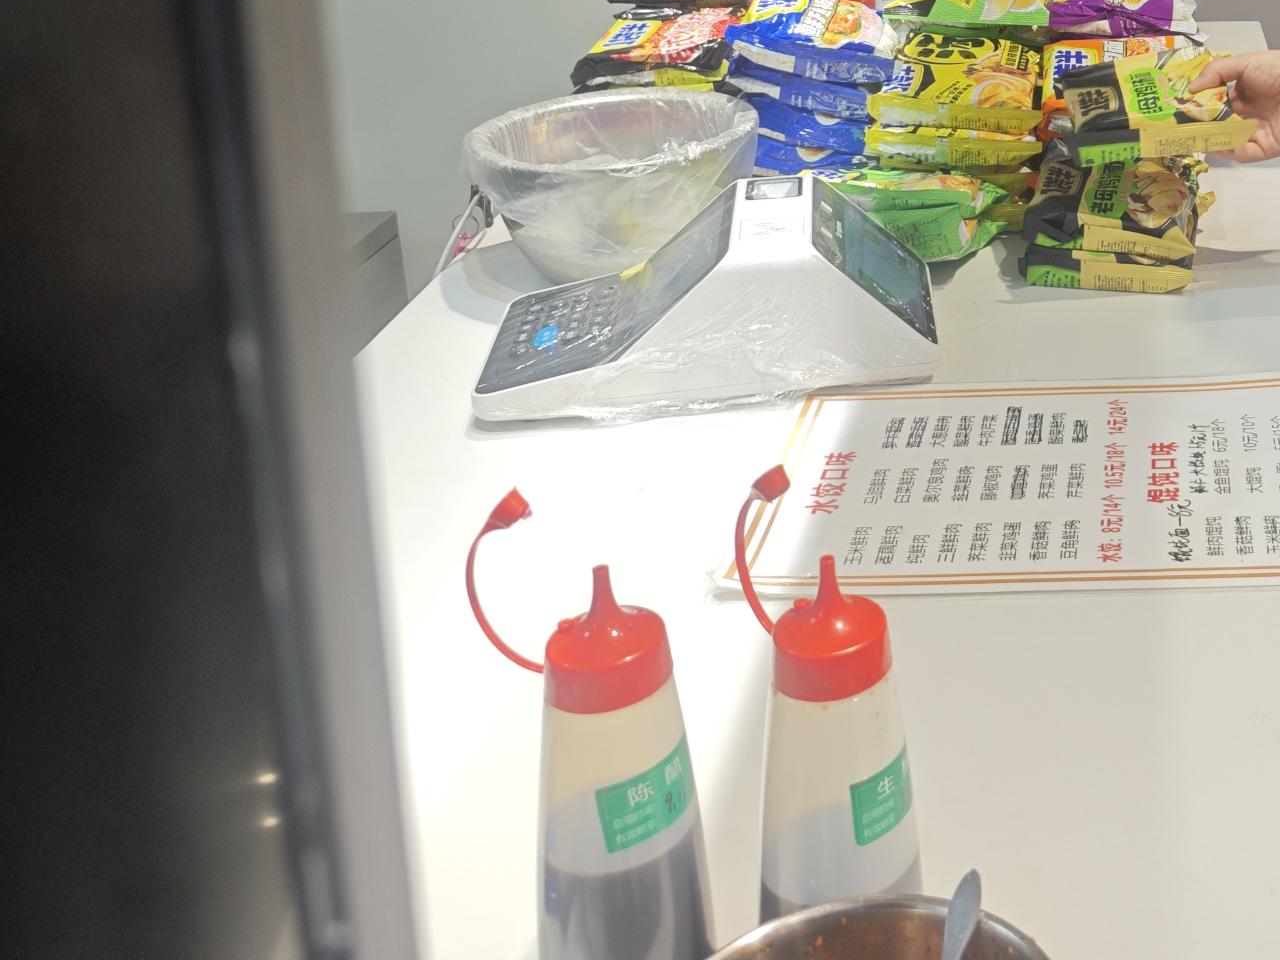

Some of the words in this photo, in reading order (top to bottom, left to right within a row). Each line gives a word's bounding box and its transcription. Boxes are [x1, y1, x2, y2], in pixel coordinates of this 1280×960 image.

[929, 416, 951, 448] 大葱鲜肉
[1107, 399, 1128, 435] 14元/24个
[1211, 419, 1228, 452] 6元/18个
[1241, 413, 1257, 452] 10元/10个
[805, 451, 857, 514] 水饺口味
[923, 459, 949, 503] 奥尔良鸡肉
[952, 465, 975, 502] 韭菜鲜肉
[1038, 464, 1058, 499] 荠菜鸡蛋
[1067, 463, 1086, 498] 芹菜鲜肉
[1104, 442, 1126, 488] 10.5元/18个
[1147, 442, 1179, 503] 馄饨口味
[1213, 459, 1231, 495] 金鱼馄饨
[1246, 467, 1263, 493] 大馄饨
[894, 468, 919, 503] 白菜鲜肉
[844, 526, 872, 565] 玉米鲜肉
[905, 535, 930, 564] 纯鲜肉
[937, 523, 962, 563] 三鲜鲜肉
[968, 522, 992, 562] 荠菜鲜肉
[998, 521, 1021, 561] 韭菜鸡蛋
[1029, 521, 1051, 560] 香菇鲜肉
[1060, 520, 1081, 560] 豆角鲜肉
[1205, 516, 1224, 556] 鲜肉馄饨
[1235, 515, 1254, 555] 香菇鲜肉
